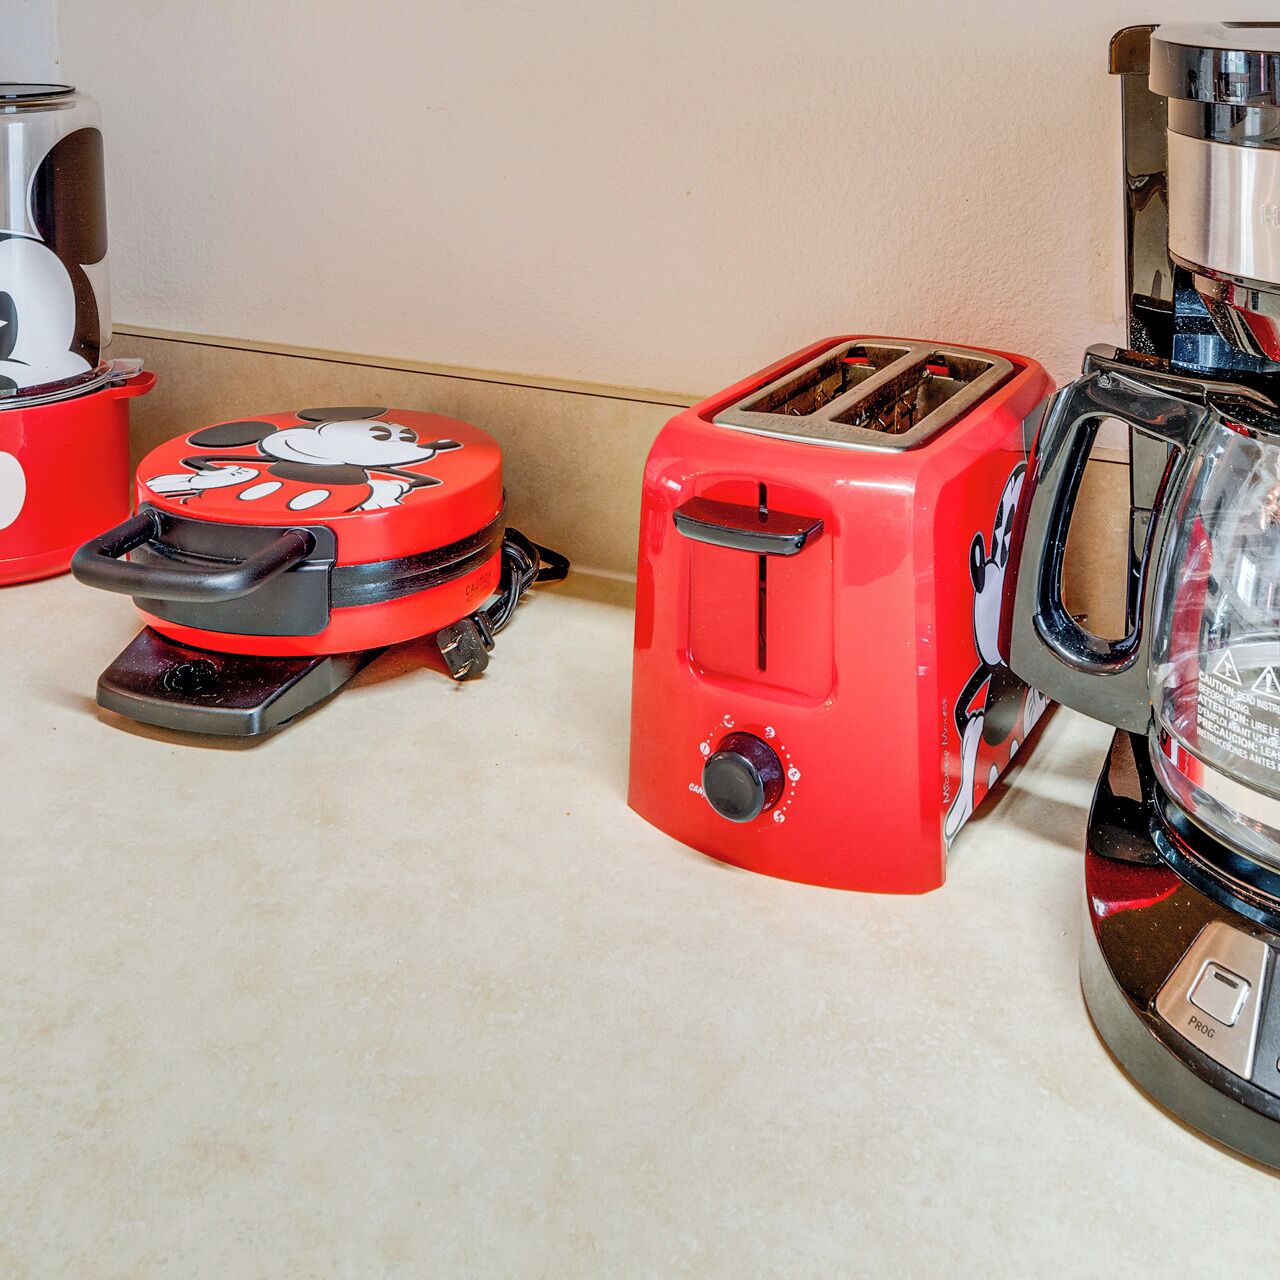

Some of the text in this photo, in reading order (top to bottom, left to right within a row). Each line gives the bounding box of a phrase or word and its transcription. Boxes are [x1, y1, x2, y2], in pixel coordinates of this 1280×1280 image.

[1199, 671, 1237, 697] CAUTION:
[1198, 685, 1251, 715] BEFORE USING.
[1198, 694, 1249, 724] ATTENTION:
[1251, 719, 1269, 734] LIRE
[1270, 726, 1280, 737] LE
[1197, 715, 1258, 752] PRECAUCION:
[1249, 754, 1276, 770] ANTES
[1188, 1015, 1215, 1039] PROG
